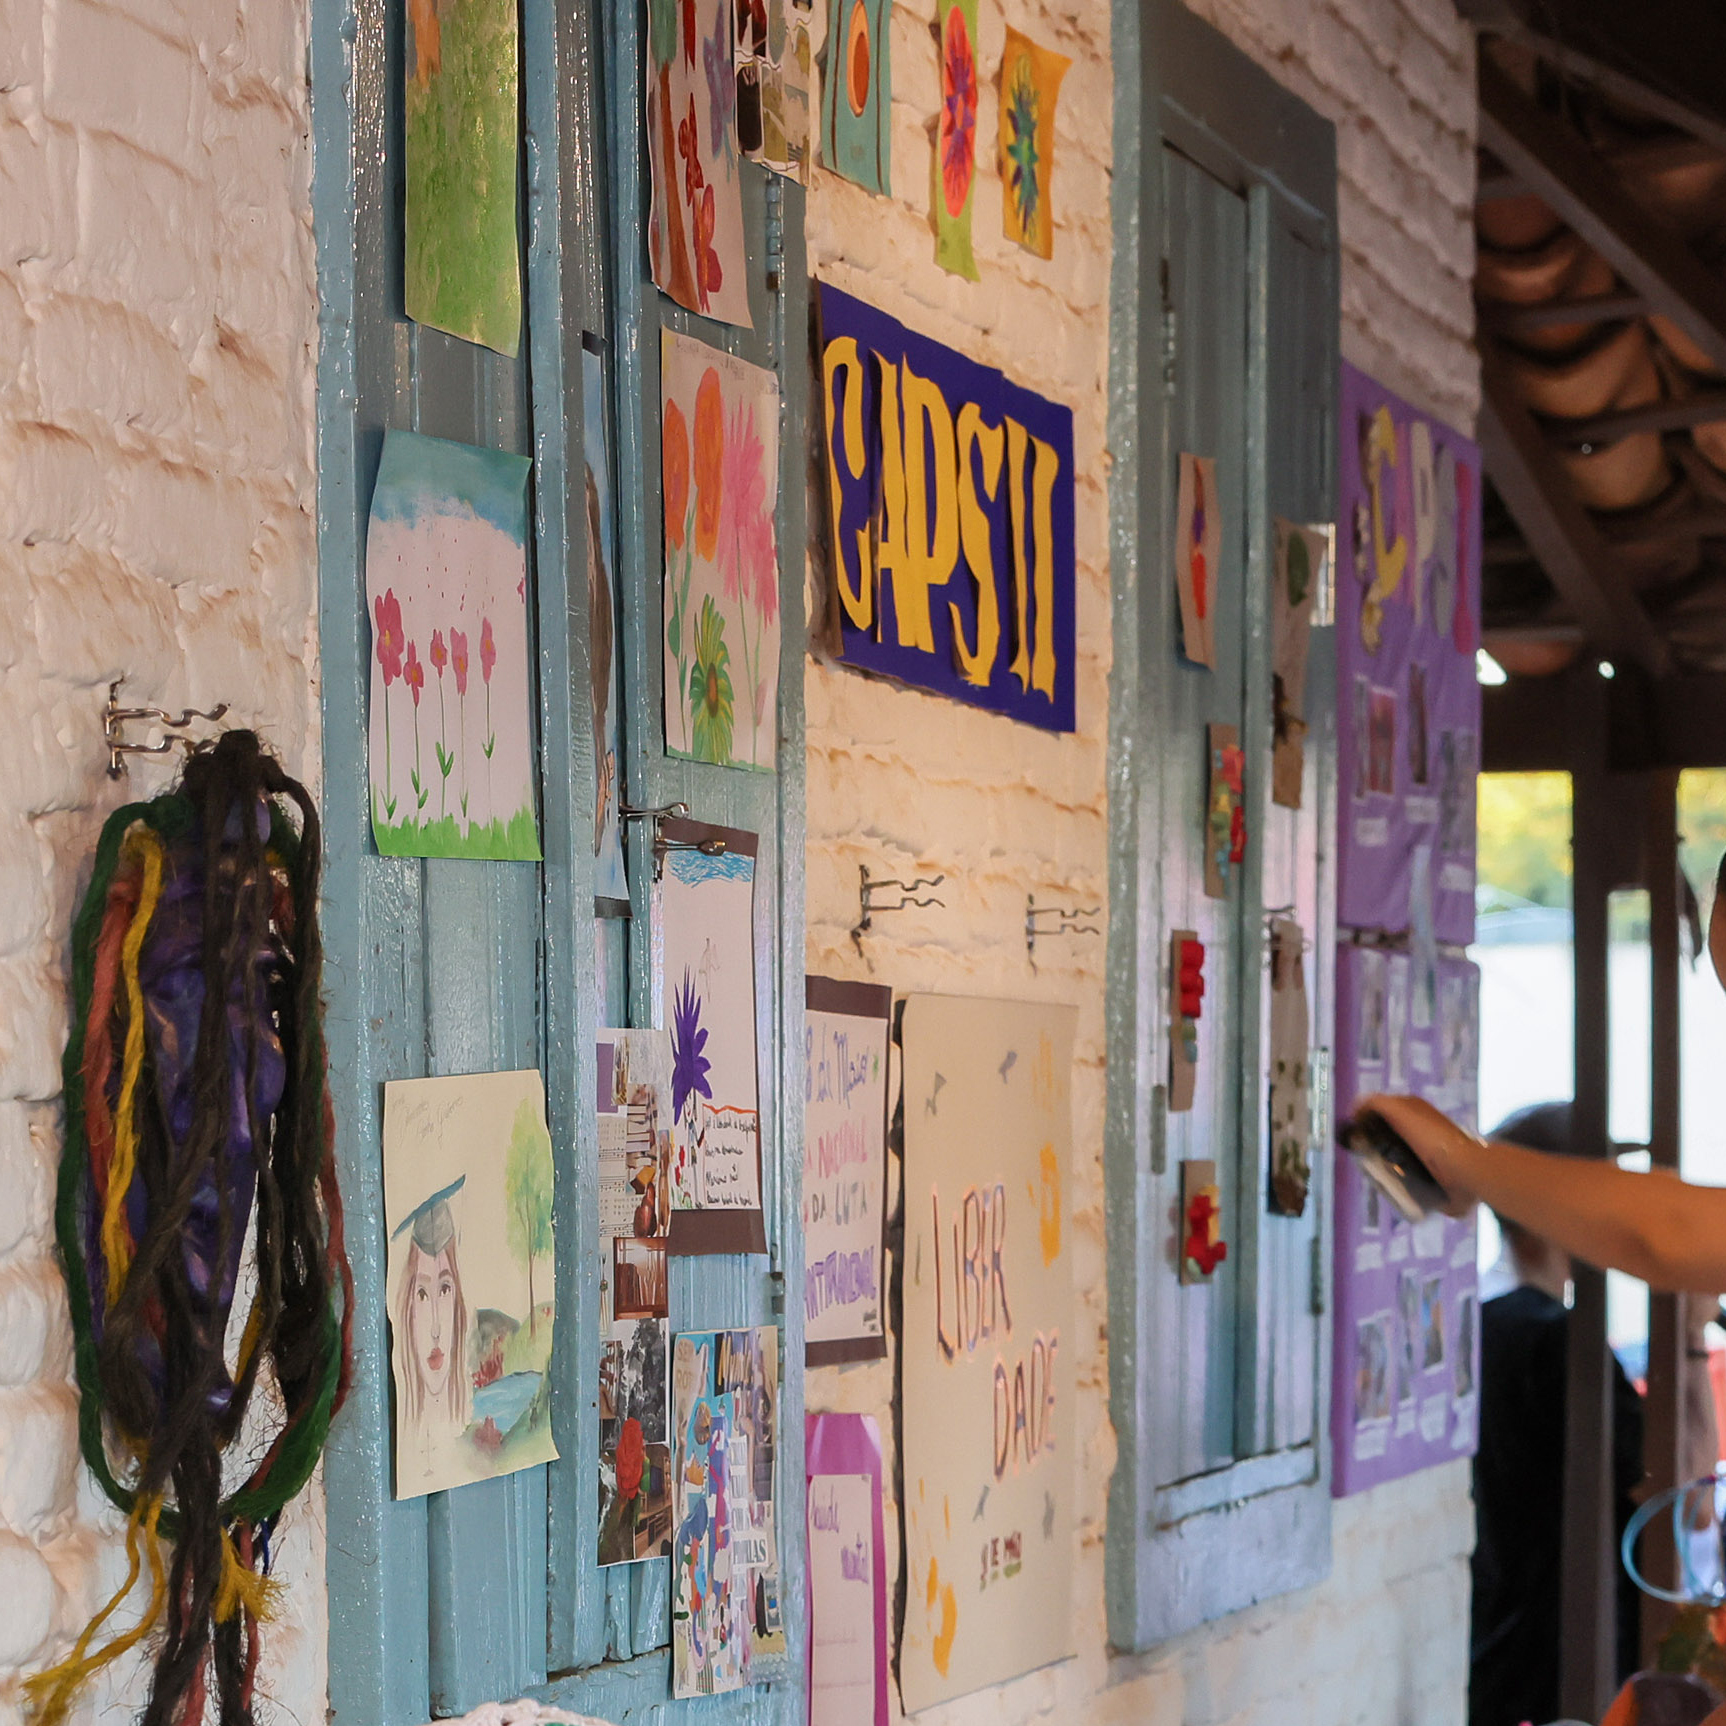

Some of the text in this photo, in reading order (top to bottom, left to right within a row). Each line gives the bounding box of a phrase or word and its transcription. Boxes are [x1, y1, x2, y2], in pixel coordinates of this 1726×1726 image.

[812, 1180, 868, 1226] DA LUTA
[932, 1183, 1013, 1363] LIBER
[993, 1329, 1059, 1481] DADE
